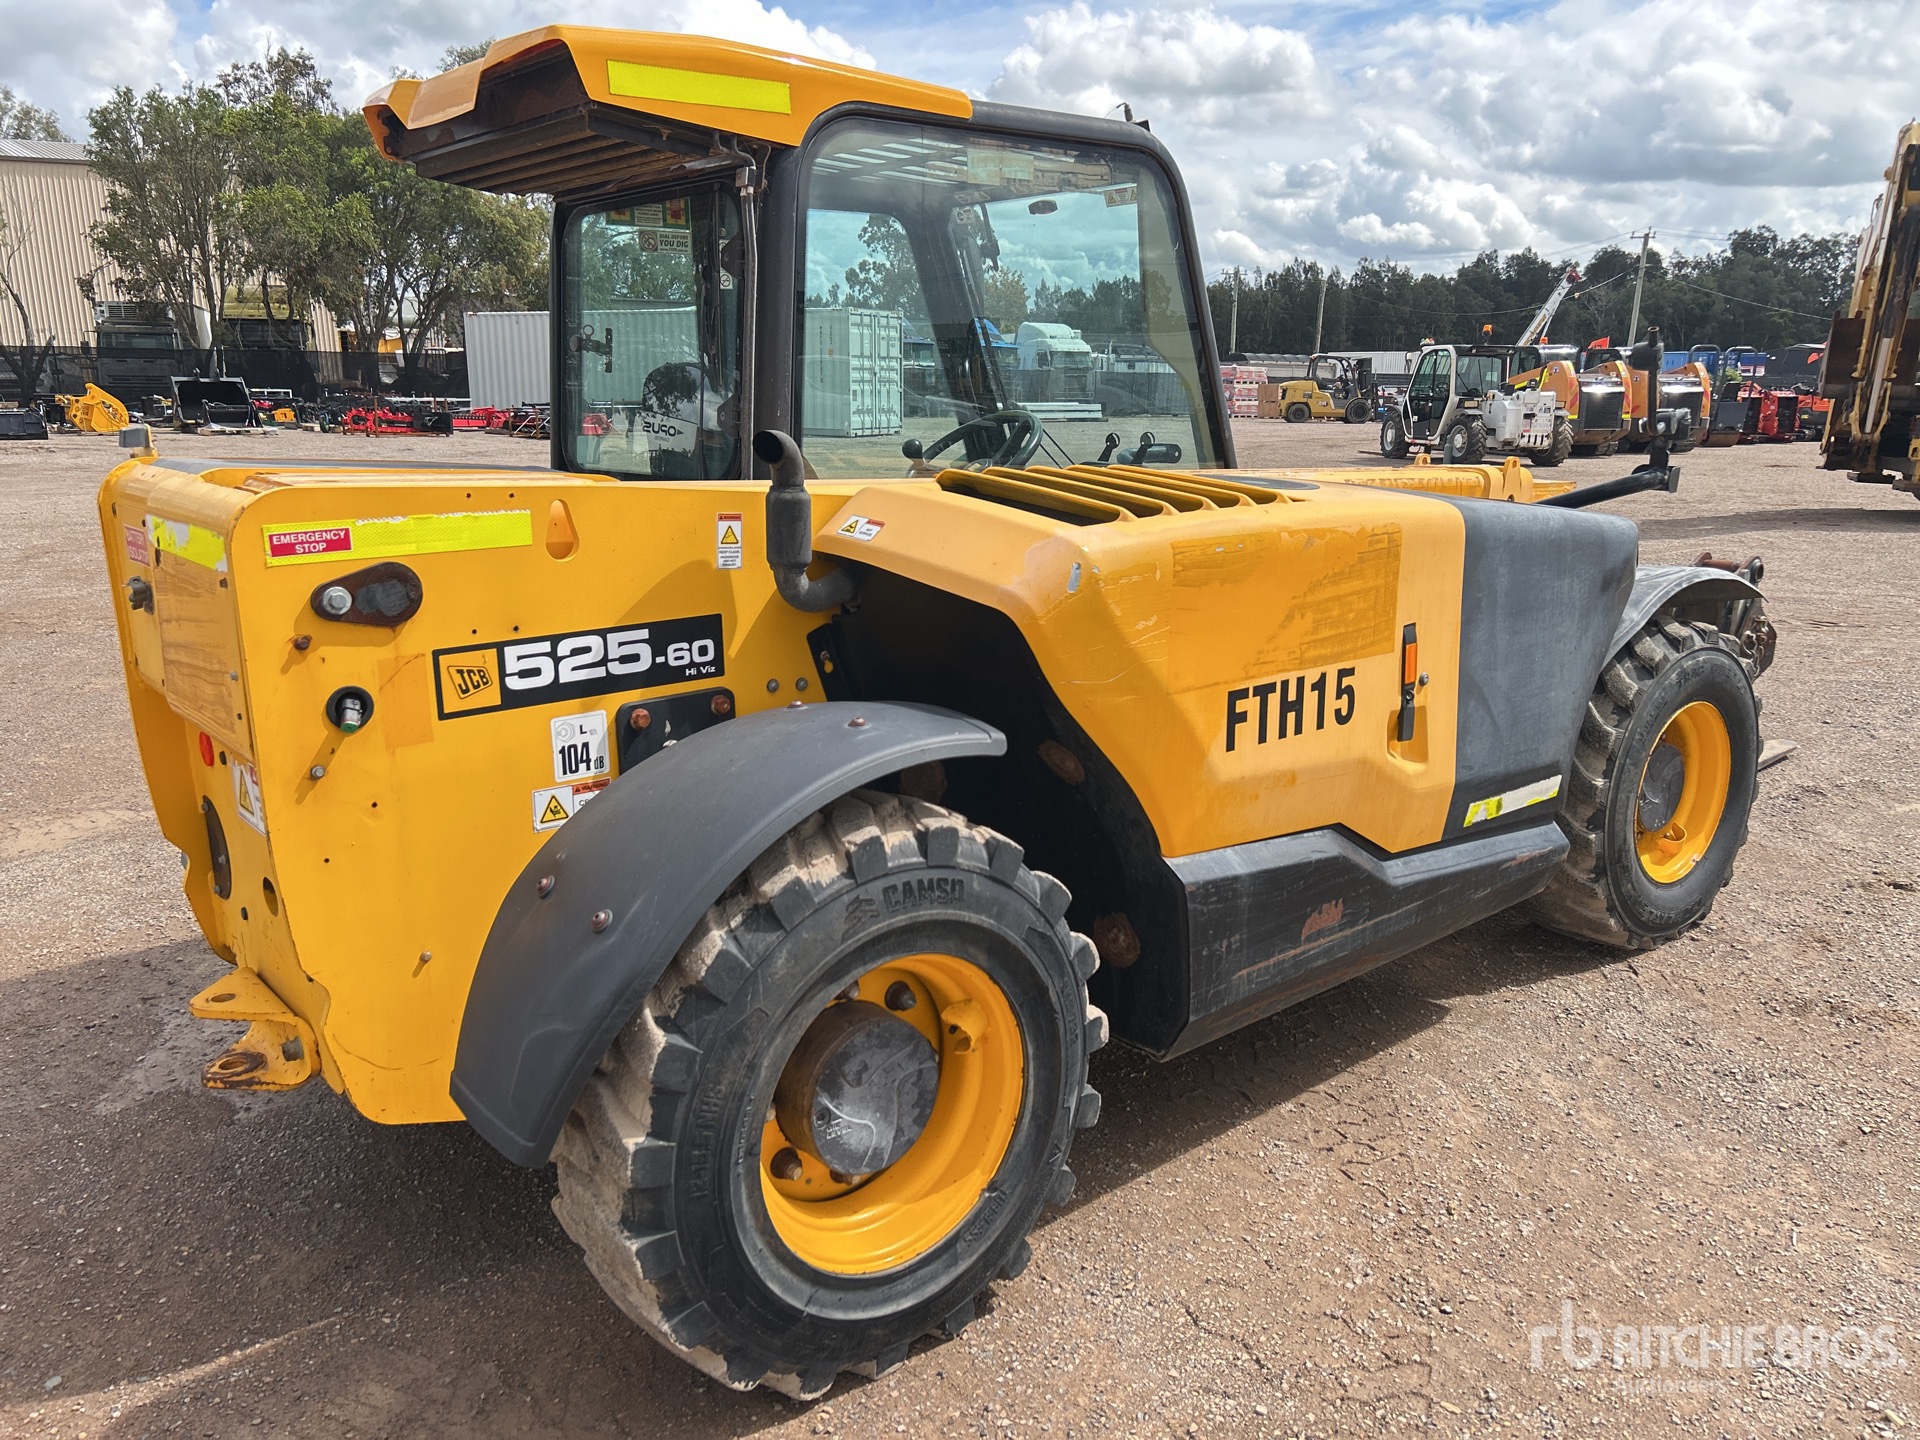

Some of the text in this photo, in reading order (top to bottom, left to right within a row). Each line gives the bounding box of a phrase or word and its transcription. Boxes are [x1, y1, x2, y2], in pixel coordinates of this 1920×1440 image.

[676, 240, 689, 248] DIG
[272, 530, 346, 545] EMERGENCY
[295, 542, 327, 554] STOP
[503, 628, 715, 691] 525-60
[685, 665, 716, 676] Hi Viz
[456, 665, 491, 696] JCB
[1225, 666, 1356, 753] FTH15
[579, 724, 587, 735] L
[558, 741, 605, 776] 104 dB
